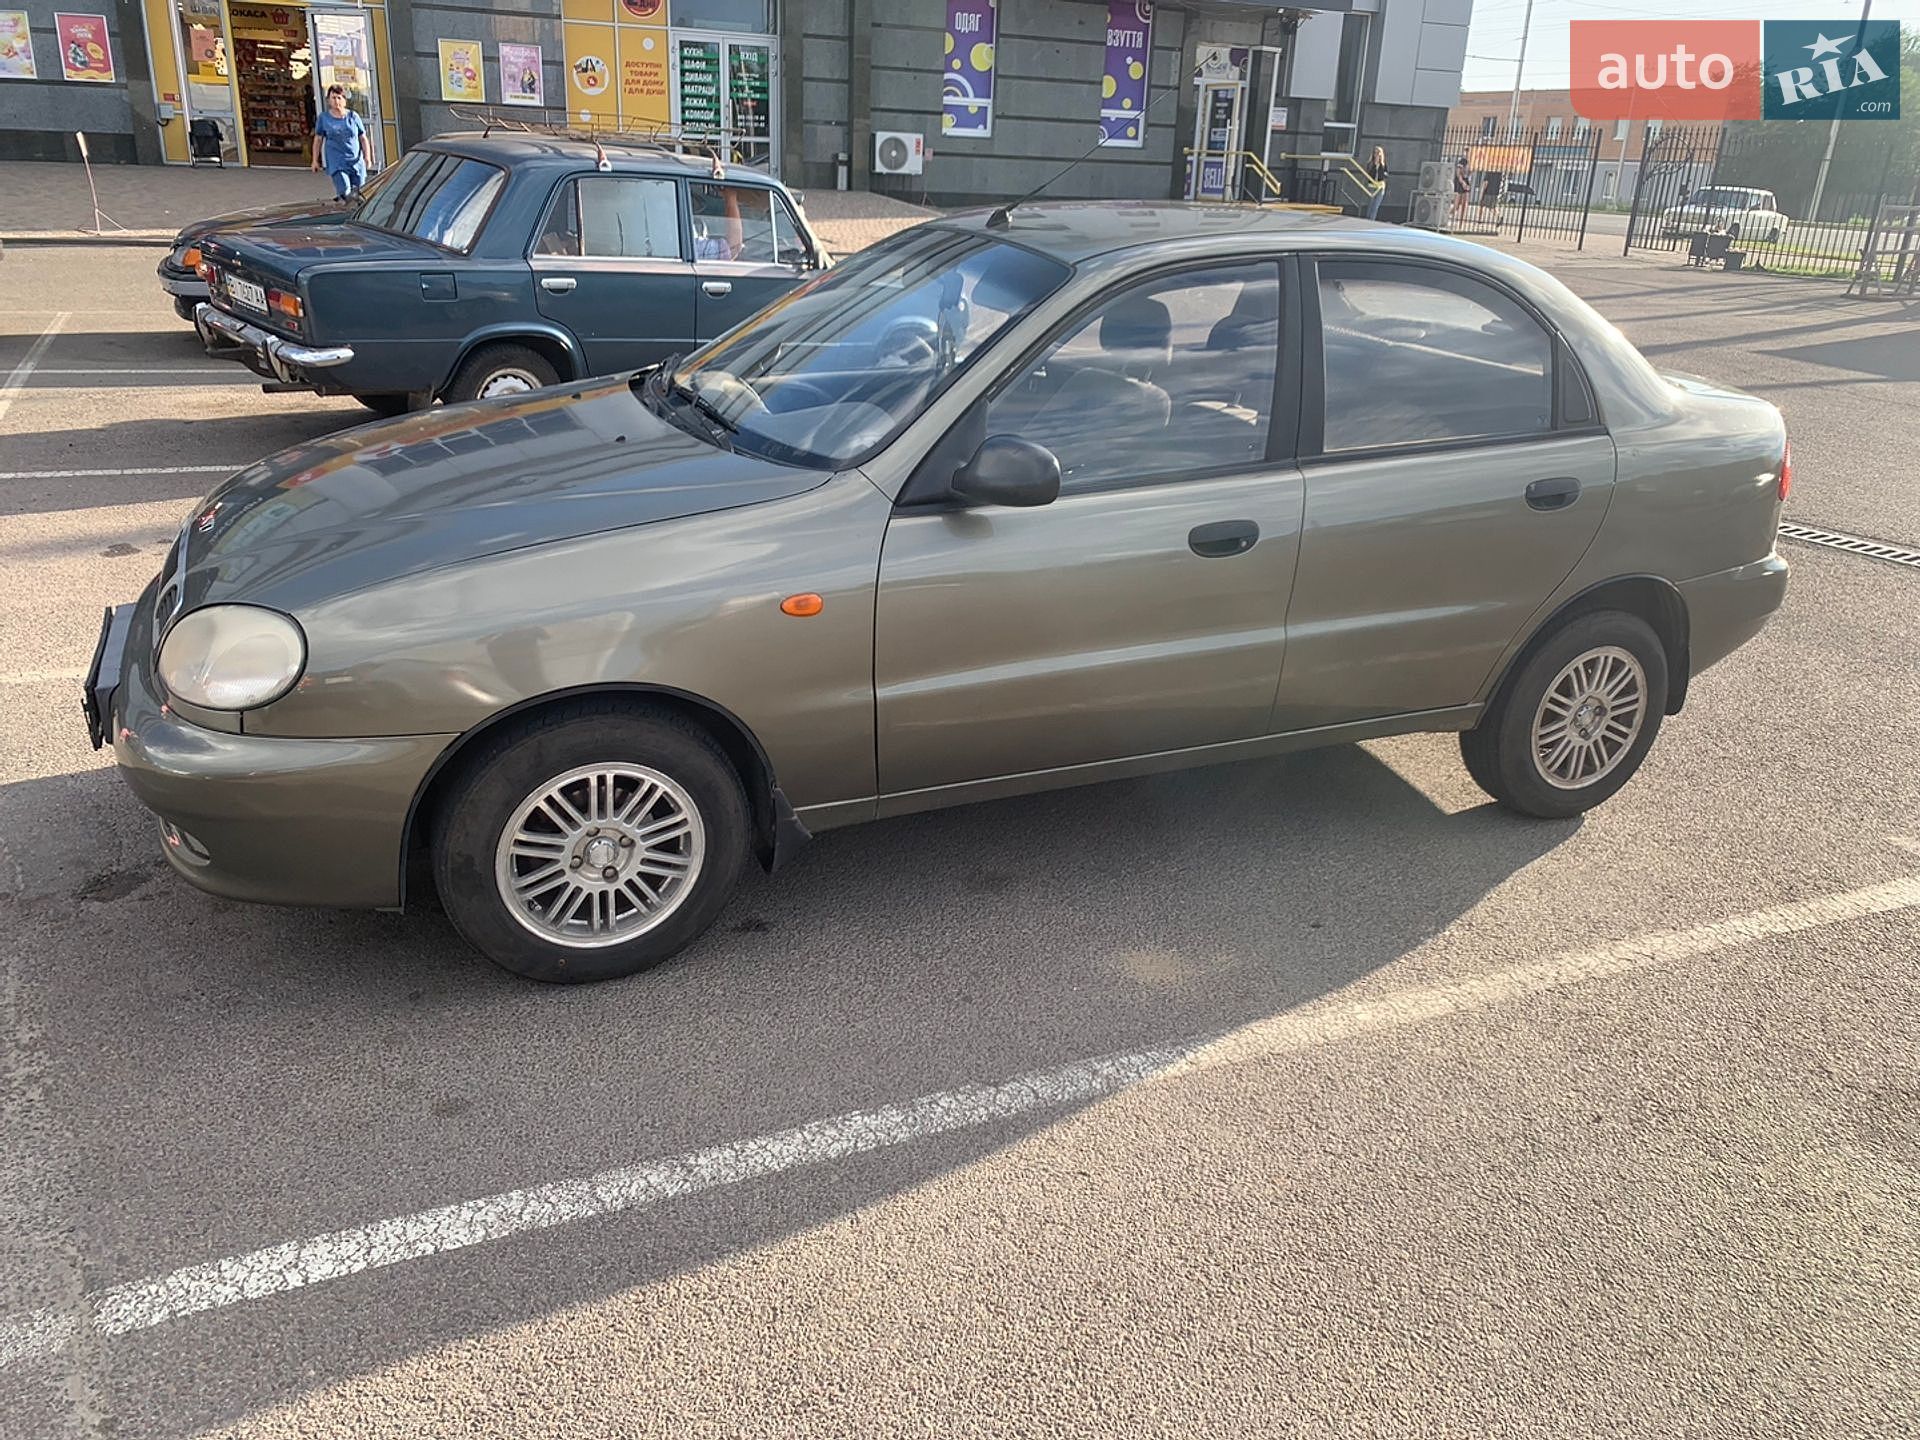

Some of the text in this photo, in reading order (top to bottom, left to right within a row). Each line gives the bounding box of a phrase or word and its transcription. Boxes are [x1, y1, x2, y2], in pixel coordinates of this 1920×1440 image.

[955, 12, 982, 33] ОДЯГ
[1106, 29, 1143, 48] ВЗУТТЯ
[740, 51, 758, 62] ВХІД
[642, 79, 664, 87] ДОМУ
[684, 72, 712, 83] ДИВАНИ
